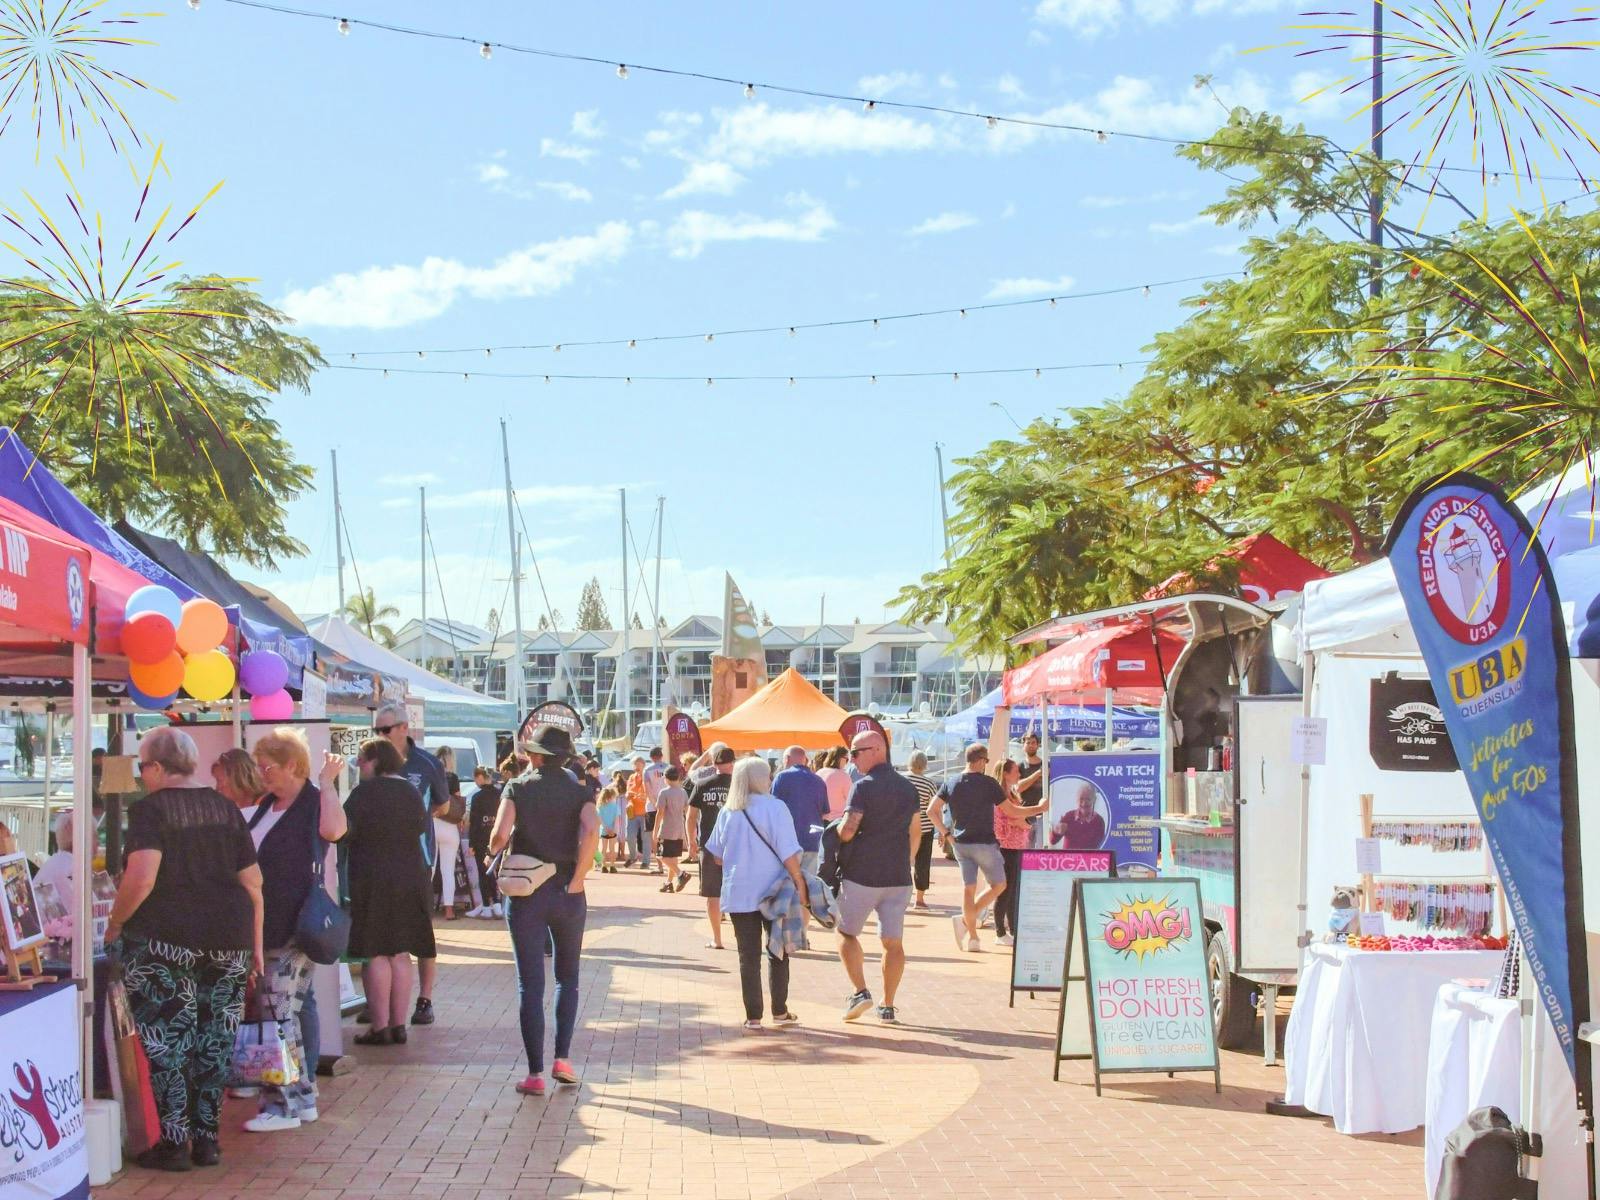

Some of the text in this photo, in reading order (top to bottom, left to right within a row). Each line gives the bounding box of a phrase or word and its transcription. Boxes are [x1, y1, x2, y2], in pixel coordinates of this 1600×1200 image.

[1452, 500, 1507, 560] DISTRICT
[3, 527, 30, 578] MP
[1420, 501, 1449, 597] REDLANDS
[1469, 620, 1498, 642] U3A
[1451, 645, 1523, 701] U3A
[1069, 718, 1103, 730] HENRY
[1396, 736, 1437, 745] HAS PAWS
[1094, 765, 1155, 777] STAR TECH
[702, 792, 729, 802] ZOO YO
[1118, 793, 1144, 801] Program
[1482, 764, 1548, 822] Over 50s
[1039, 857, 1109, 872] SUGARS
[1104, 906, 1193, 950] OMG!
[1098, 978, 1201, 996] HOT FRESH
[1100, 997, 1205, 1019] DONUTS
[1143, 1020, 1206, 1040] VEGAN
